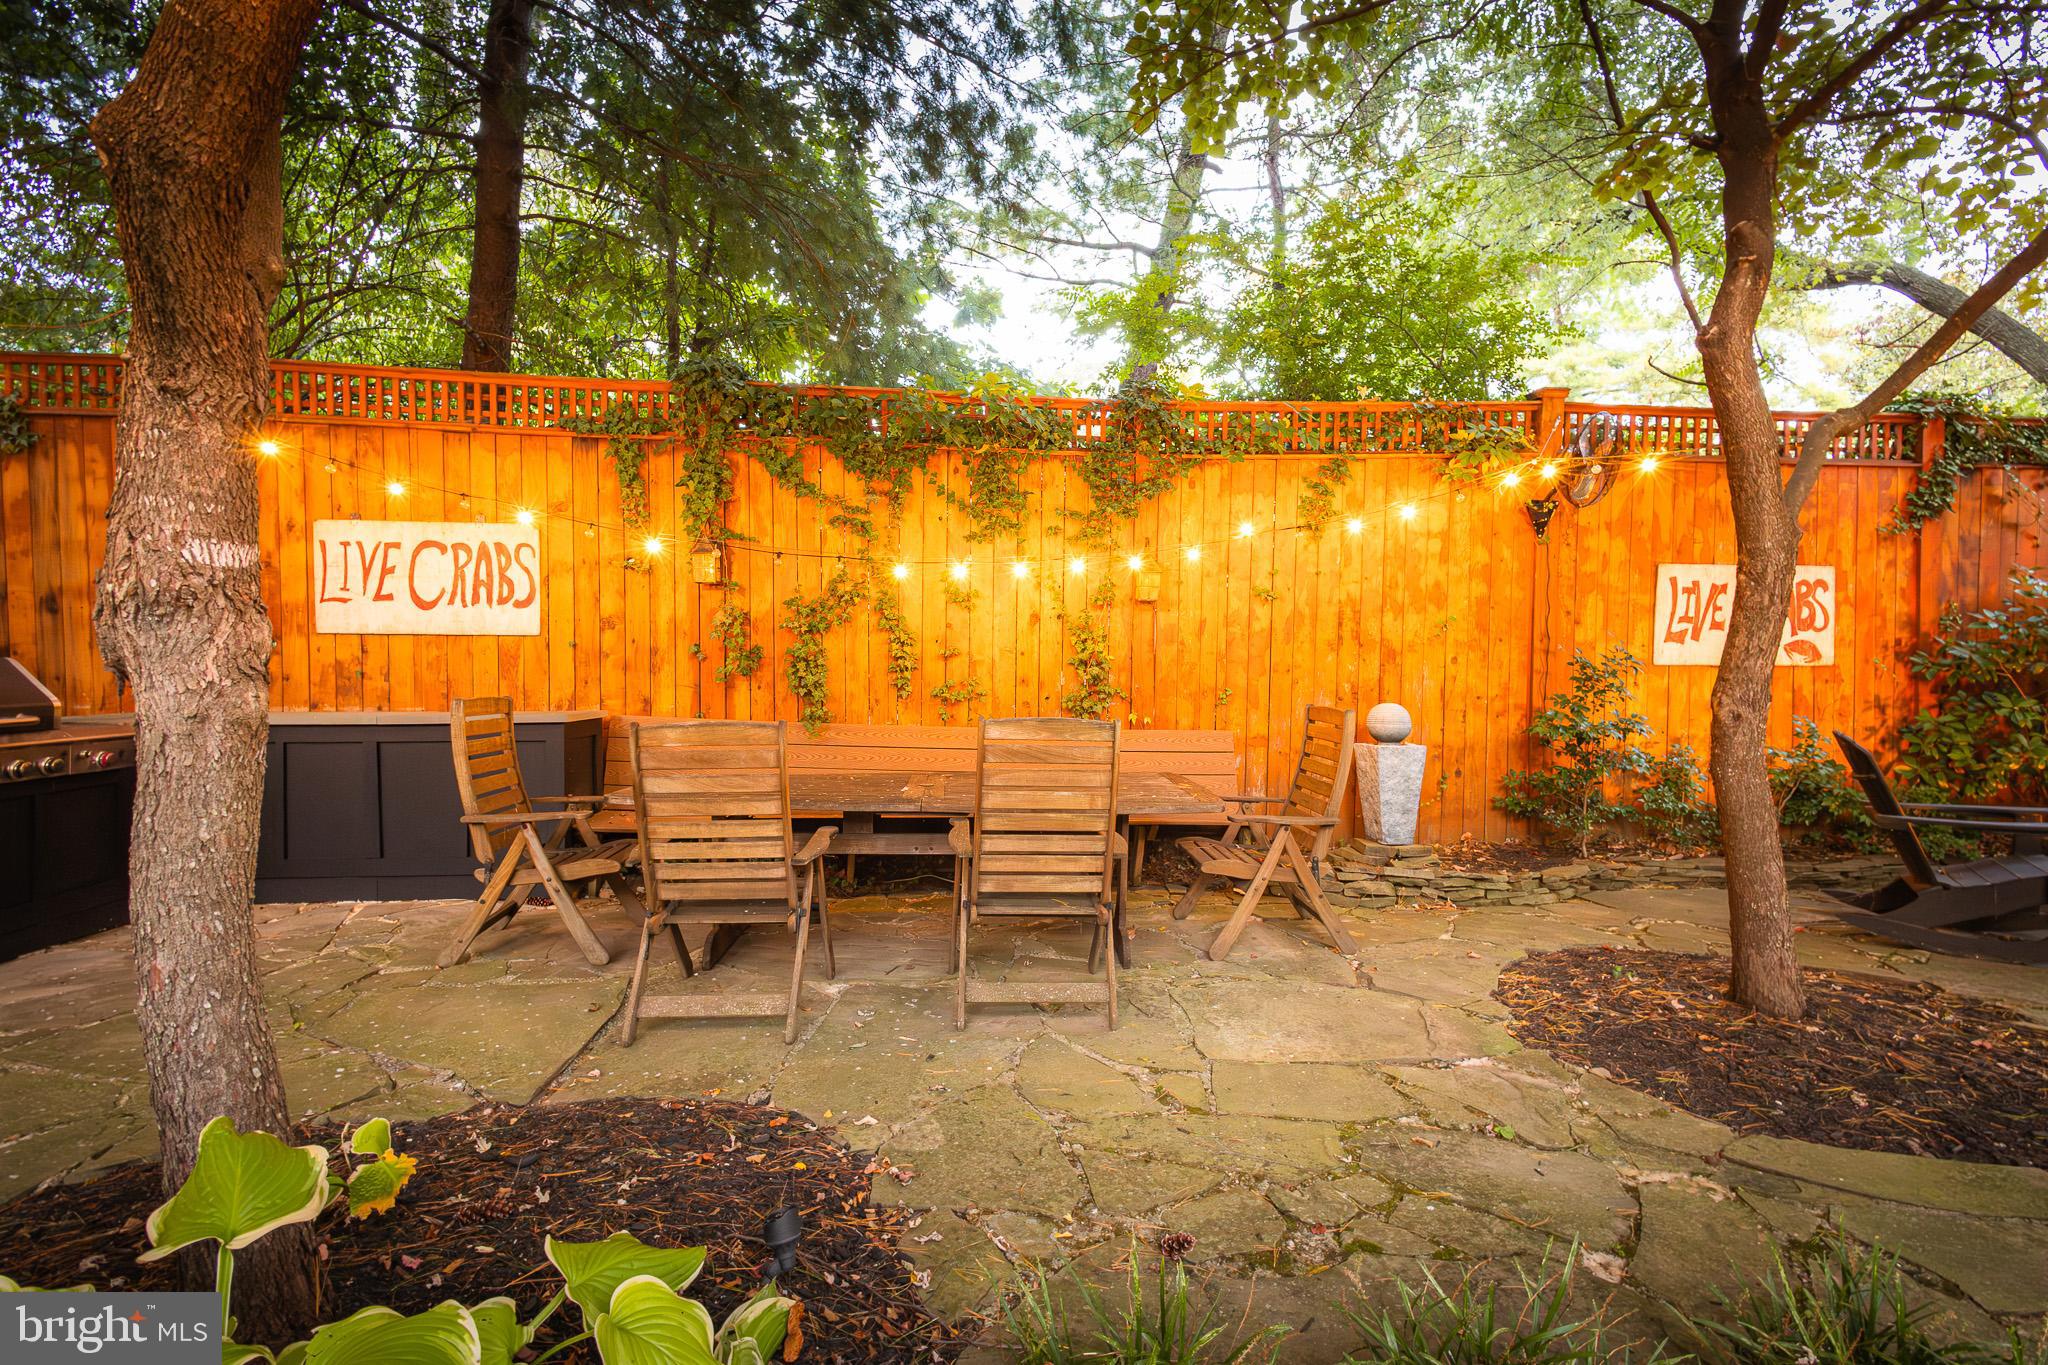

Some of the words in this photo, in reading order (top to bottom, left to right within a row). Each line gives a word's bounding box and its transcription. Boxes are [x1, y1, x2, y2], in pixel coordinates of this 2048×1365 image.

[318, 539, 401, 604] LIVE
[408, 539, 536, 611] CRABS
[1663, 575, 1729, 645] LIVE
